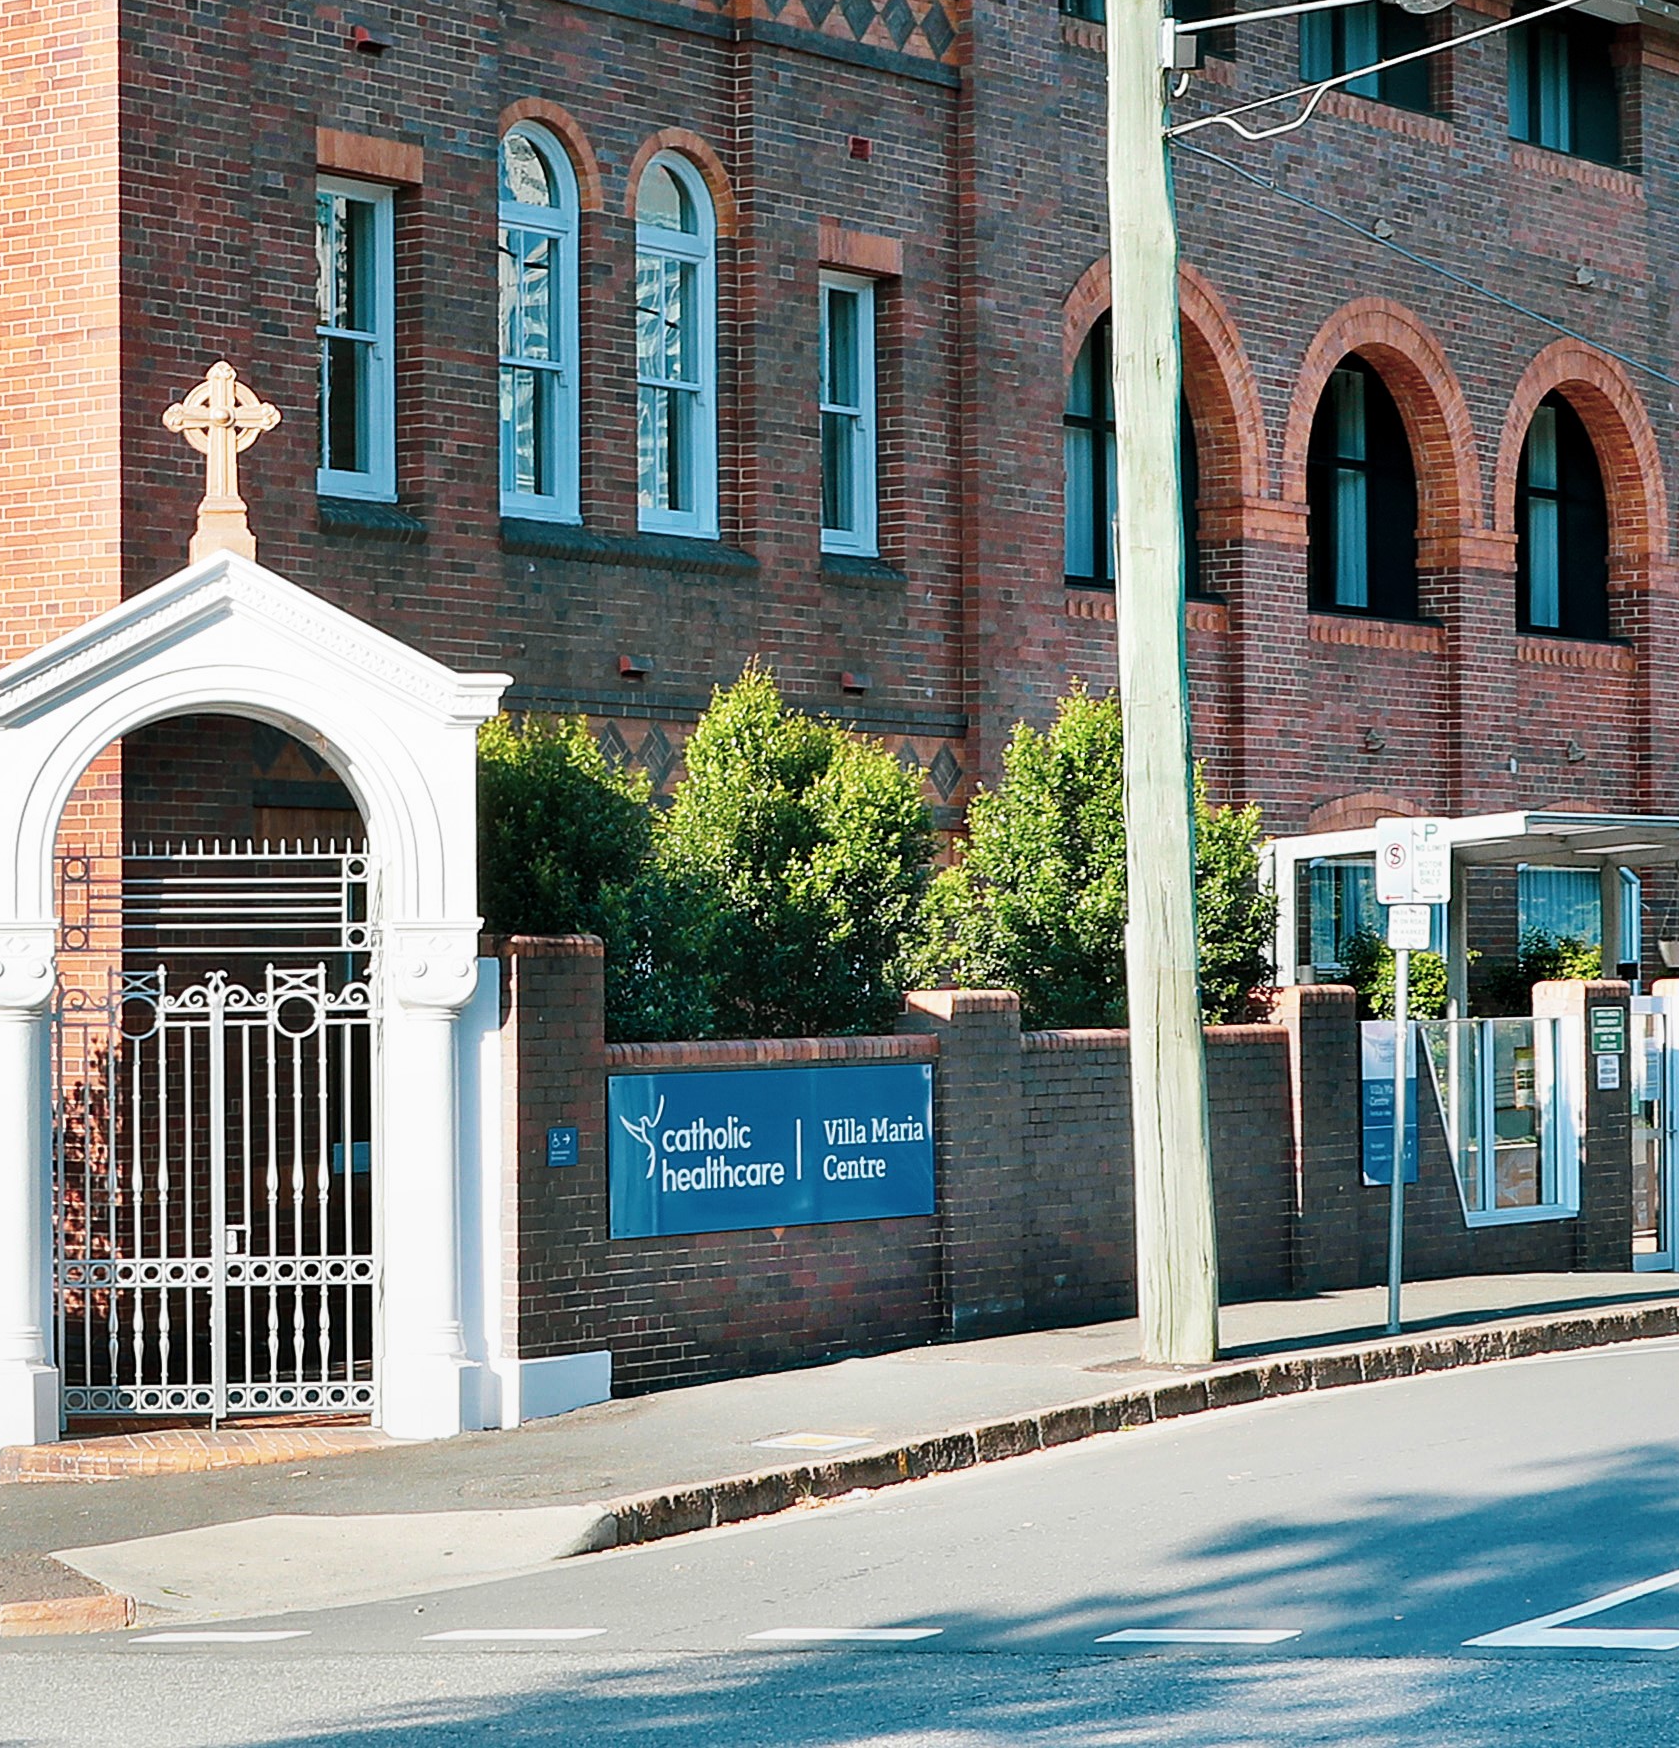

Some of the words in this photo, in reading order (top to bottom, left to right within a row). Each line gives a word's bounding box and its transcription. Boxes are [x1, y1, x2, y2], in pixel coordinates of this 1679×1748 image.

[1425, 823, 1438, 842] P
[662, 1115, 752, 1152] catholic
[823, 1118, 867, 1145] Villa
[871, 1115, 924, 1143] Maria
[662, 1155, 785, 1192] healthcare
[823, 1154, 886, 1181] Centre
